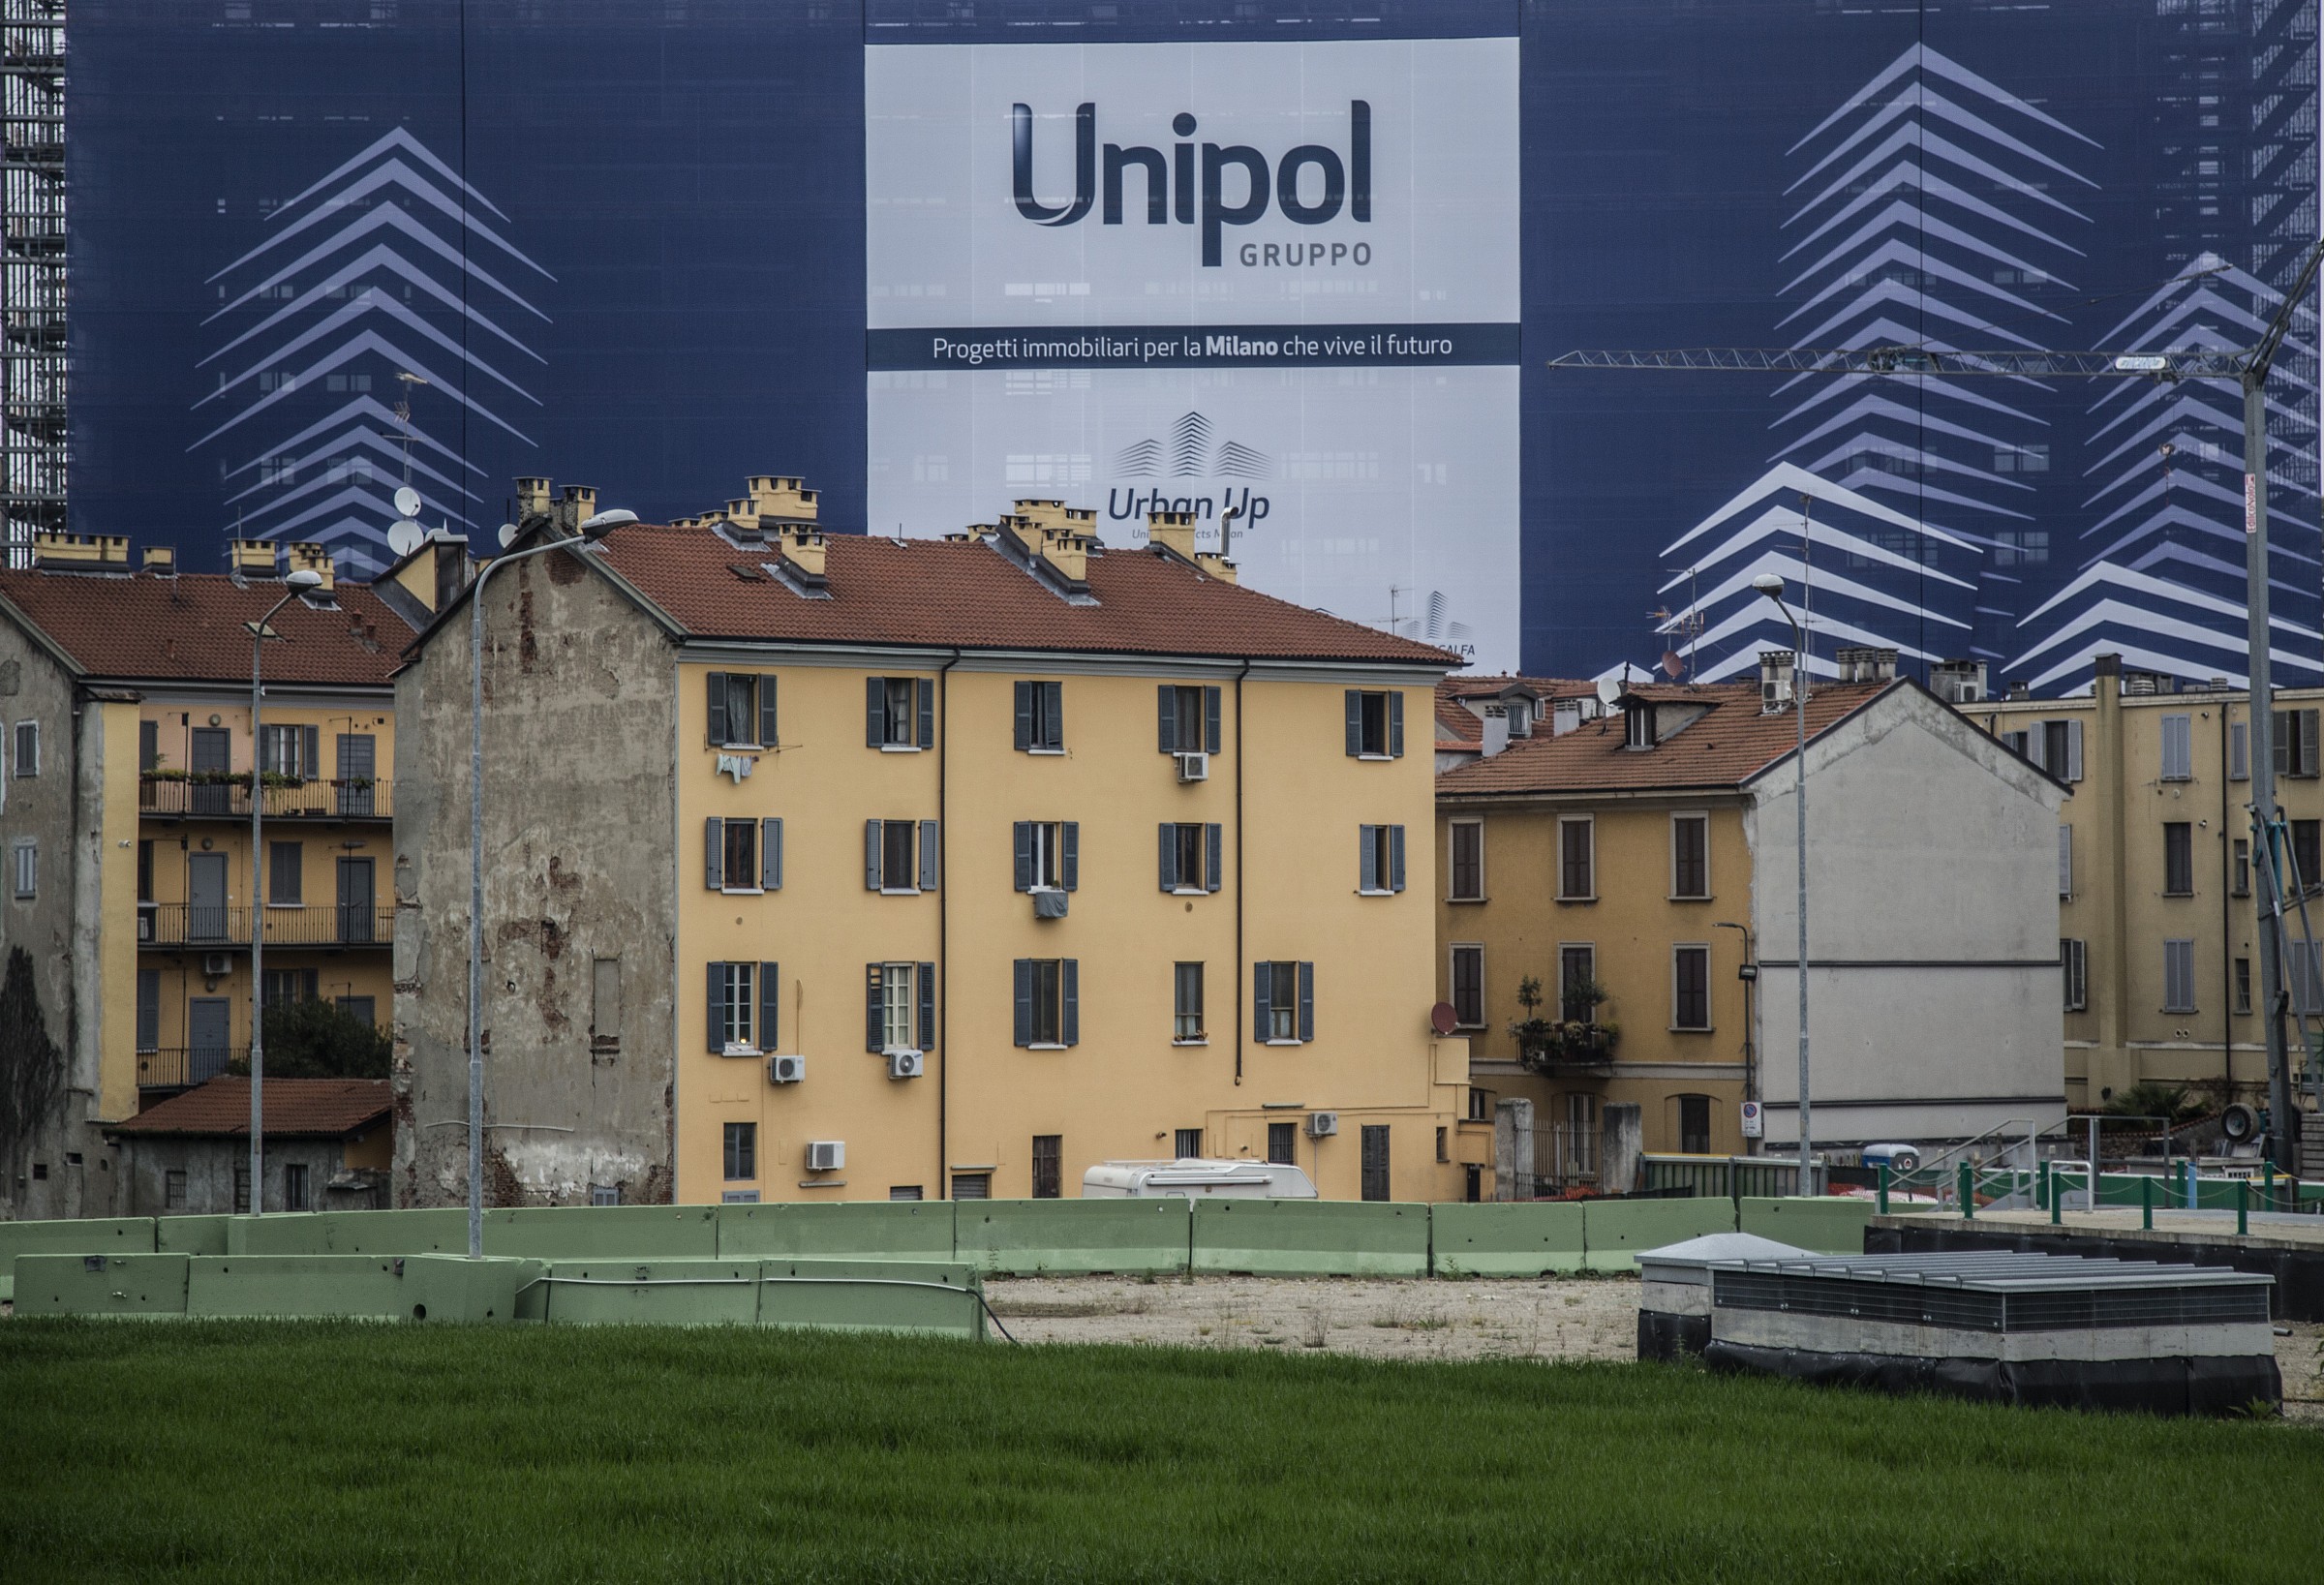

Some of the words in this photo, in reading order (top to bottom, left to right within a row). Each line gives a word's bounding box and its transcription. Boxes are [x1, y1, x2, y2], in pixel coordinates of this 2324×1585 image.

[1012, 99, 1371, 267] Unipol
[1238, 242, 1372, 268] GRUPPO
[933, 337, 1018, 364] Progetti
[1023, 336, 1139, 358] immobiliari
[1144, 340, 1178, 363] per
[1183, 336, 1201, 356] la
[1206, 335, 1278, 356] Milano
[1283, 335, 1319, 355] che
[1323, 336, 1365, 355] vive
[1370, 334, 1382, 354] il
[1387, 334, 1452, 354] futuro
[1109, 488, 1213, 520] Urban
[1223, 487, 1270, 530] Up
